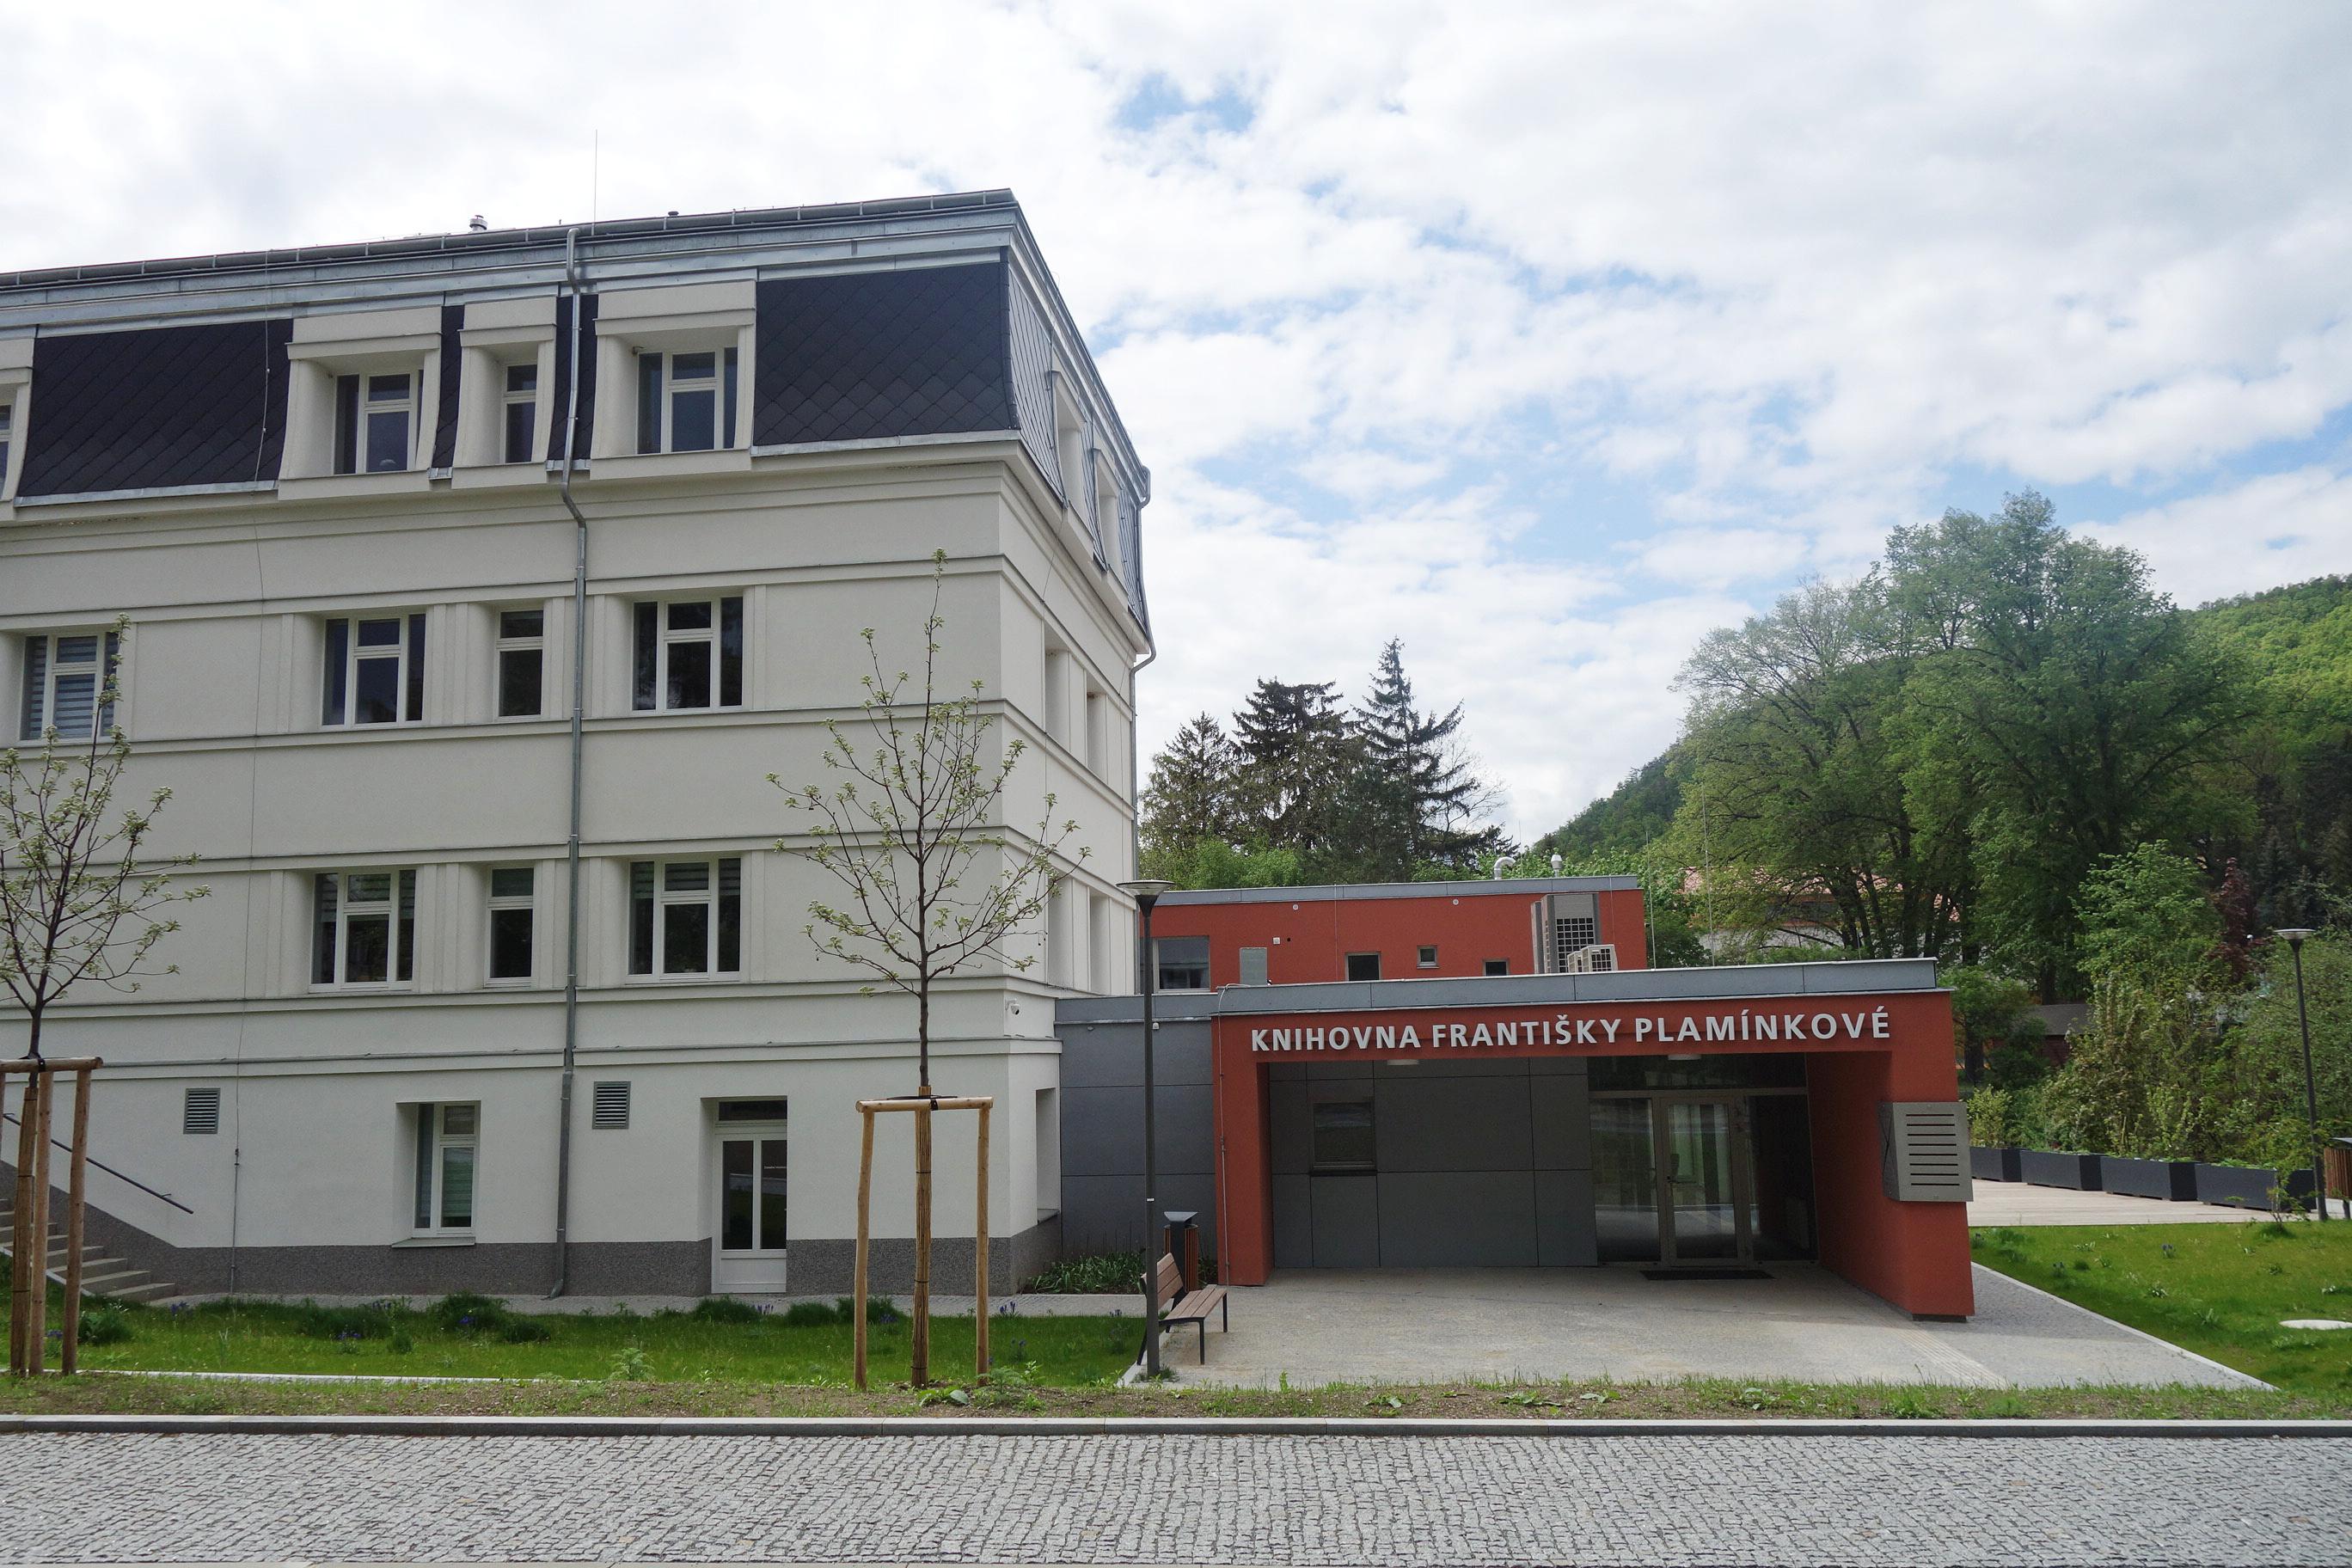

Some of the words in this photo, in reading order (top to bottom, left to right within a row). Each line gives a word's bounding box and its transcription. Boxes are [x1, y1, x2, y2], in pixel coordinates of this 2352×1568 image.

[1251, 1025, 1421, 1051] KNIHOVNA
[1432, 1014, 1621, 1047] FRANTIŠKY
[1635, 1005, 1890, 1043] PLAMÍNKOVÉ
